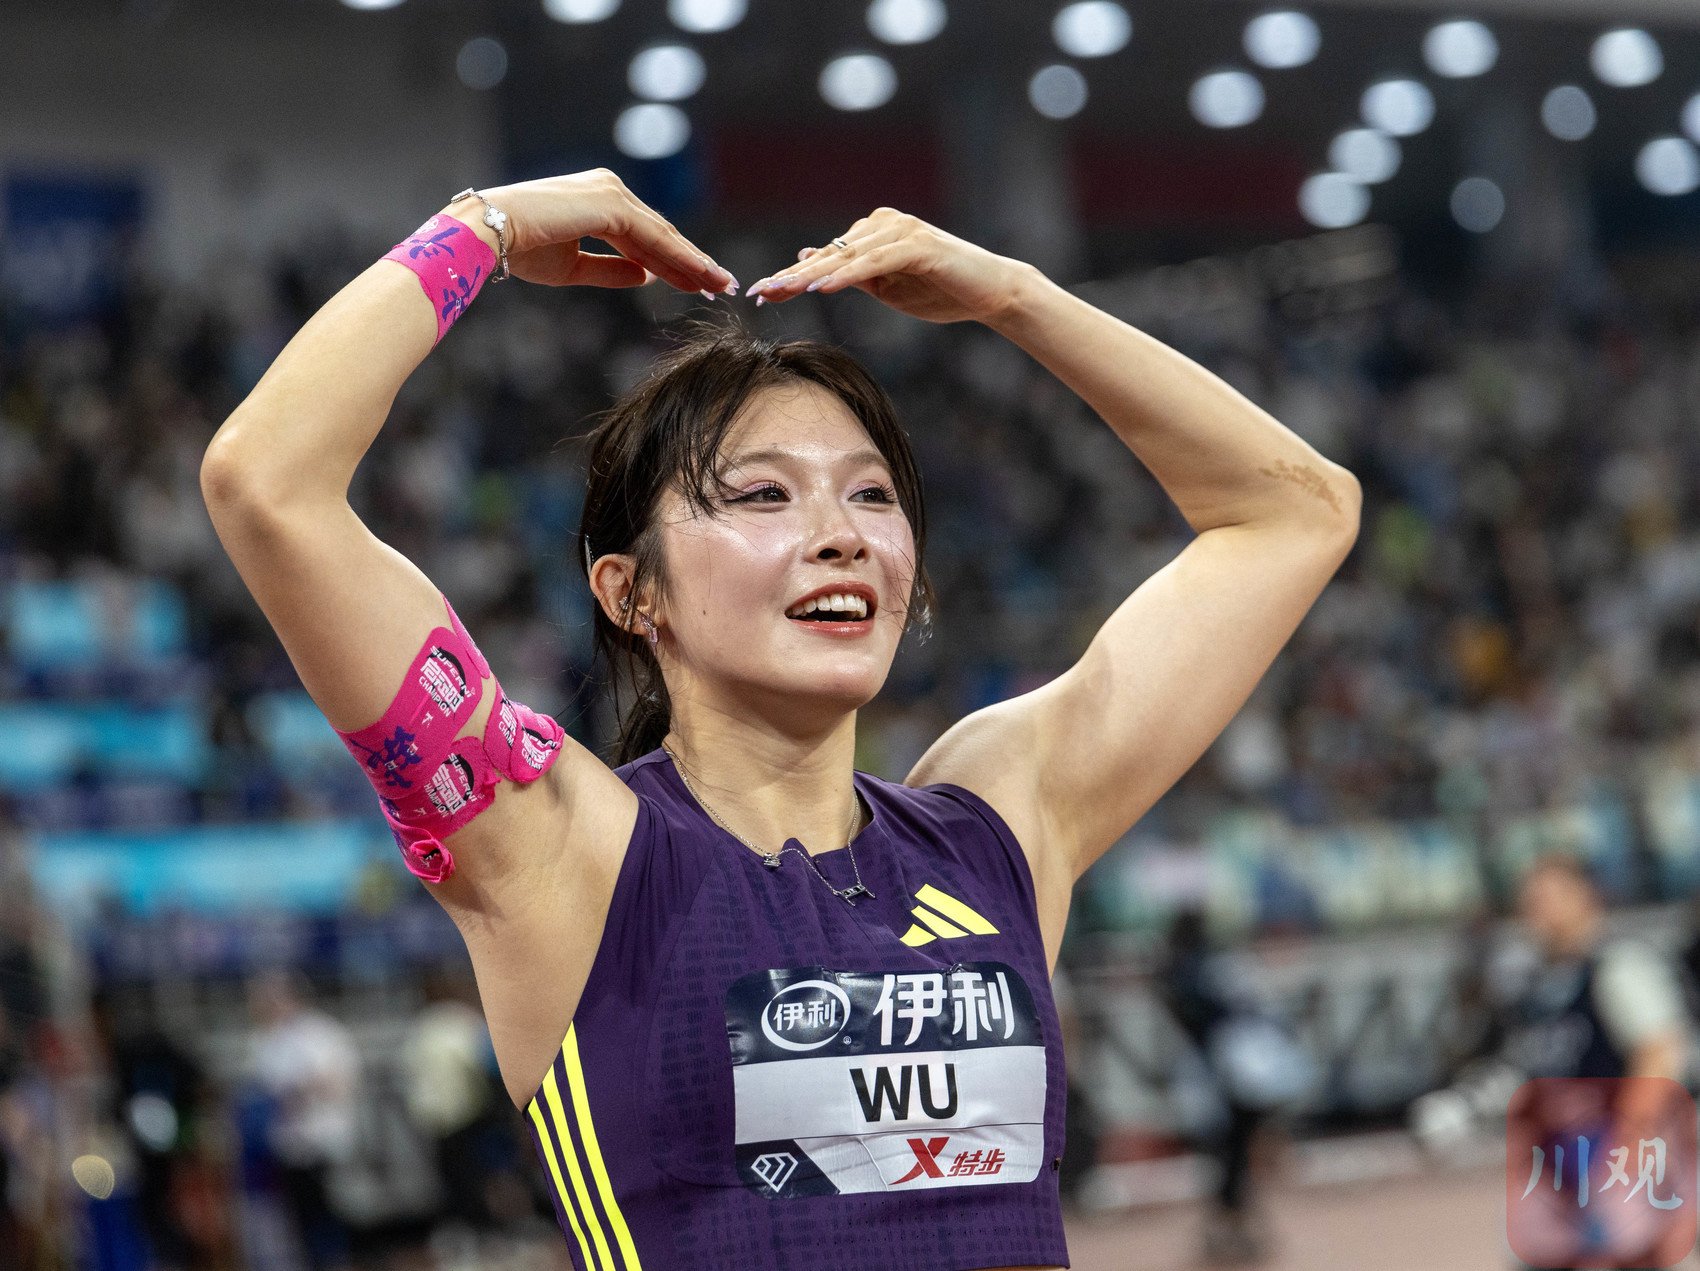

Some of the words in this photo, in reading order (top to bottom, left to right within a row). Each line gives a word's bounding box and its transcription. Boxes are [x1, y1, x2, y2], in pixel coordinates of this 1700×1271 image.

[419, 676, 452, 717] CHAMPION
[773, 999, 836, 1031] 伊利
[873, 971, 1014, 1046] 伊利
[850, 1063, 958, 1123] WU
[947, 1148, 1006, 1177] 特步
